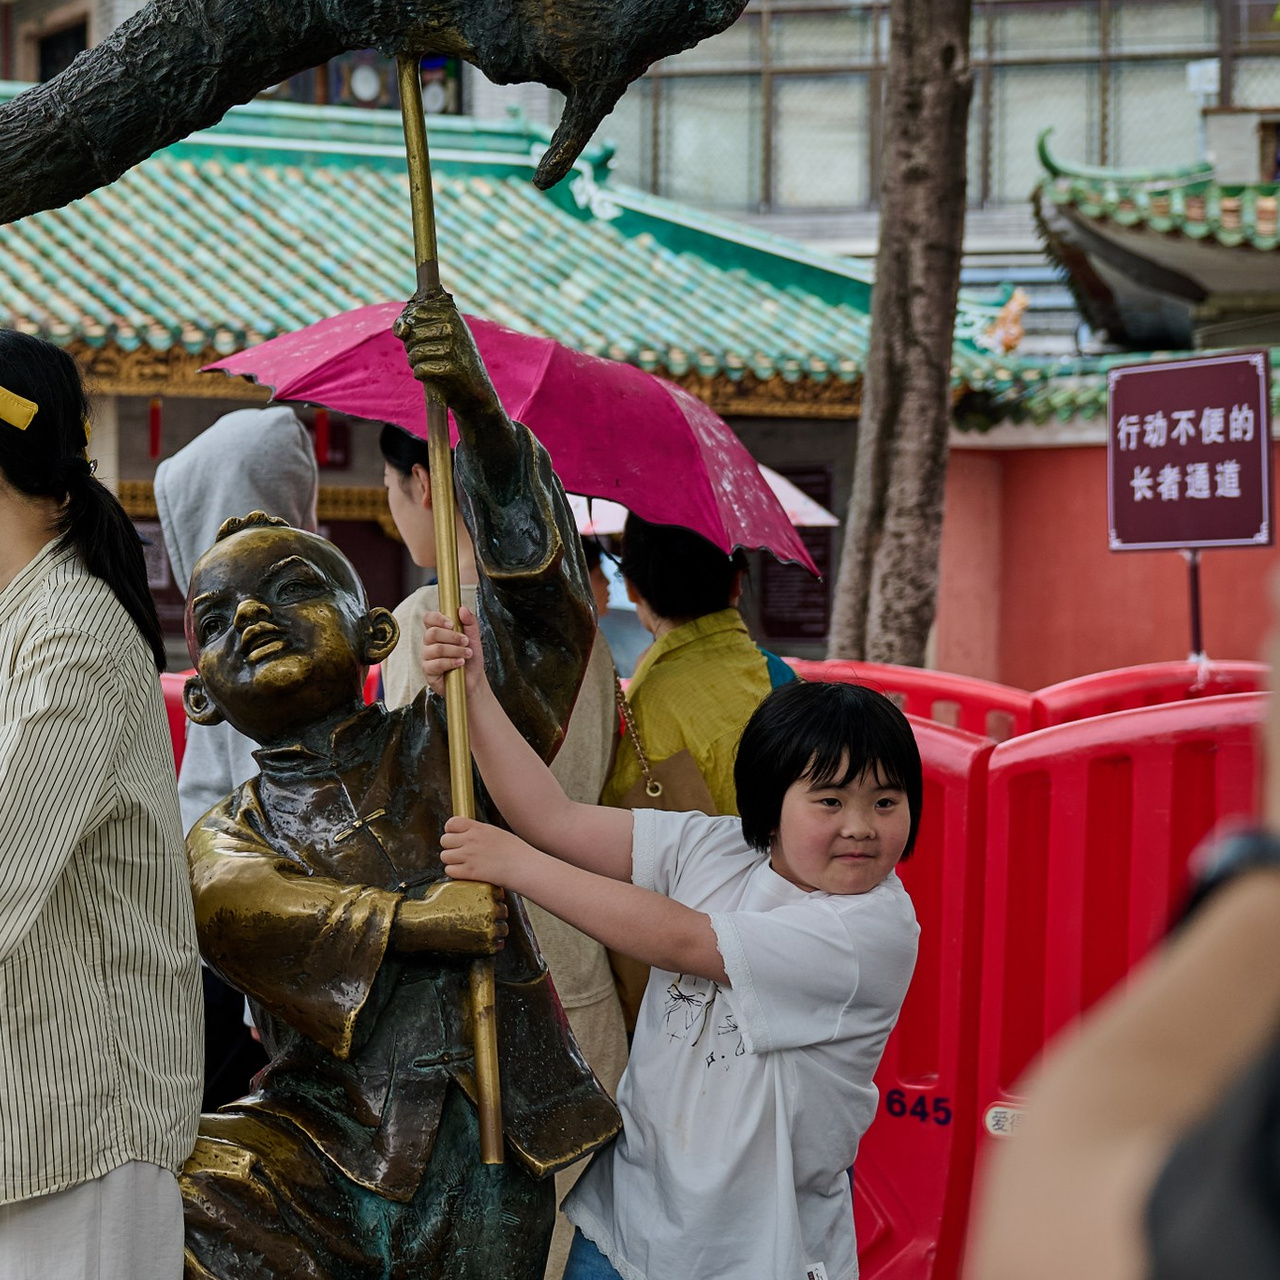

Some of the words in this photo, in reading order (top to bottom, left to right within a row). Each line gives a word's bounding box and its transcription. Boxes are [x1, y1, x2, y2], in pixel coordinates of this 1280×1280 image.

[1117, 403, 1255, 451] 行动不便的
[1130, 459, 1241, 502] 长者通道
[886, 1089, 952, 1125] 645
